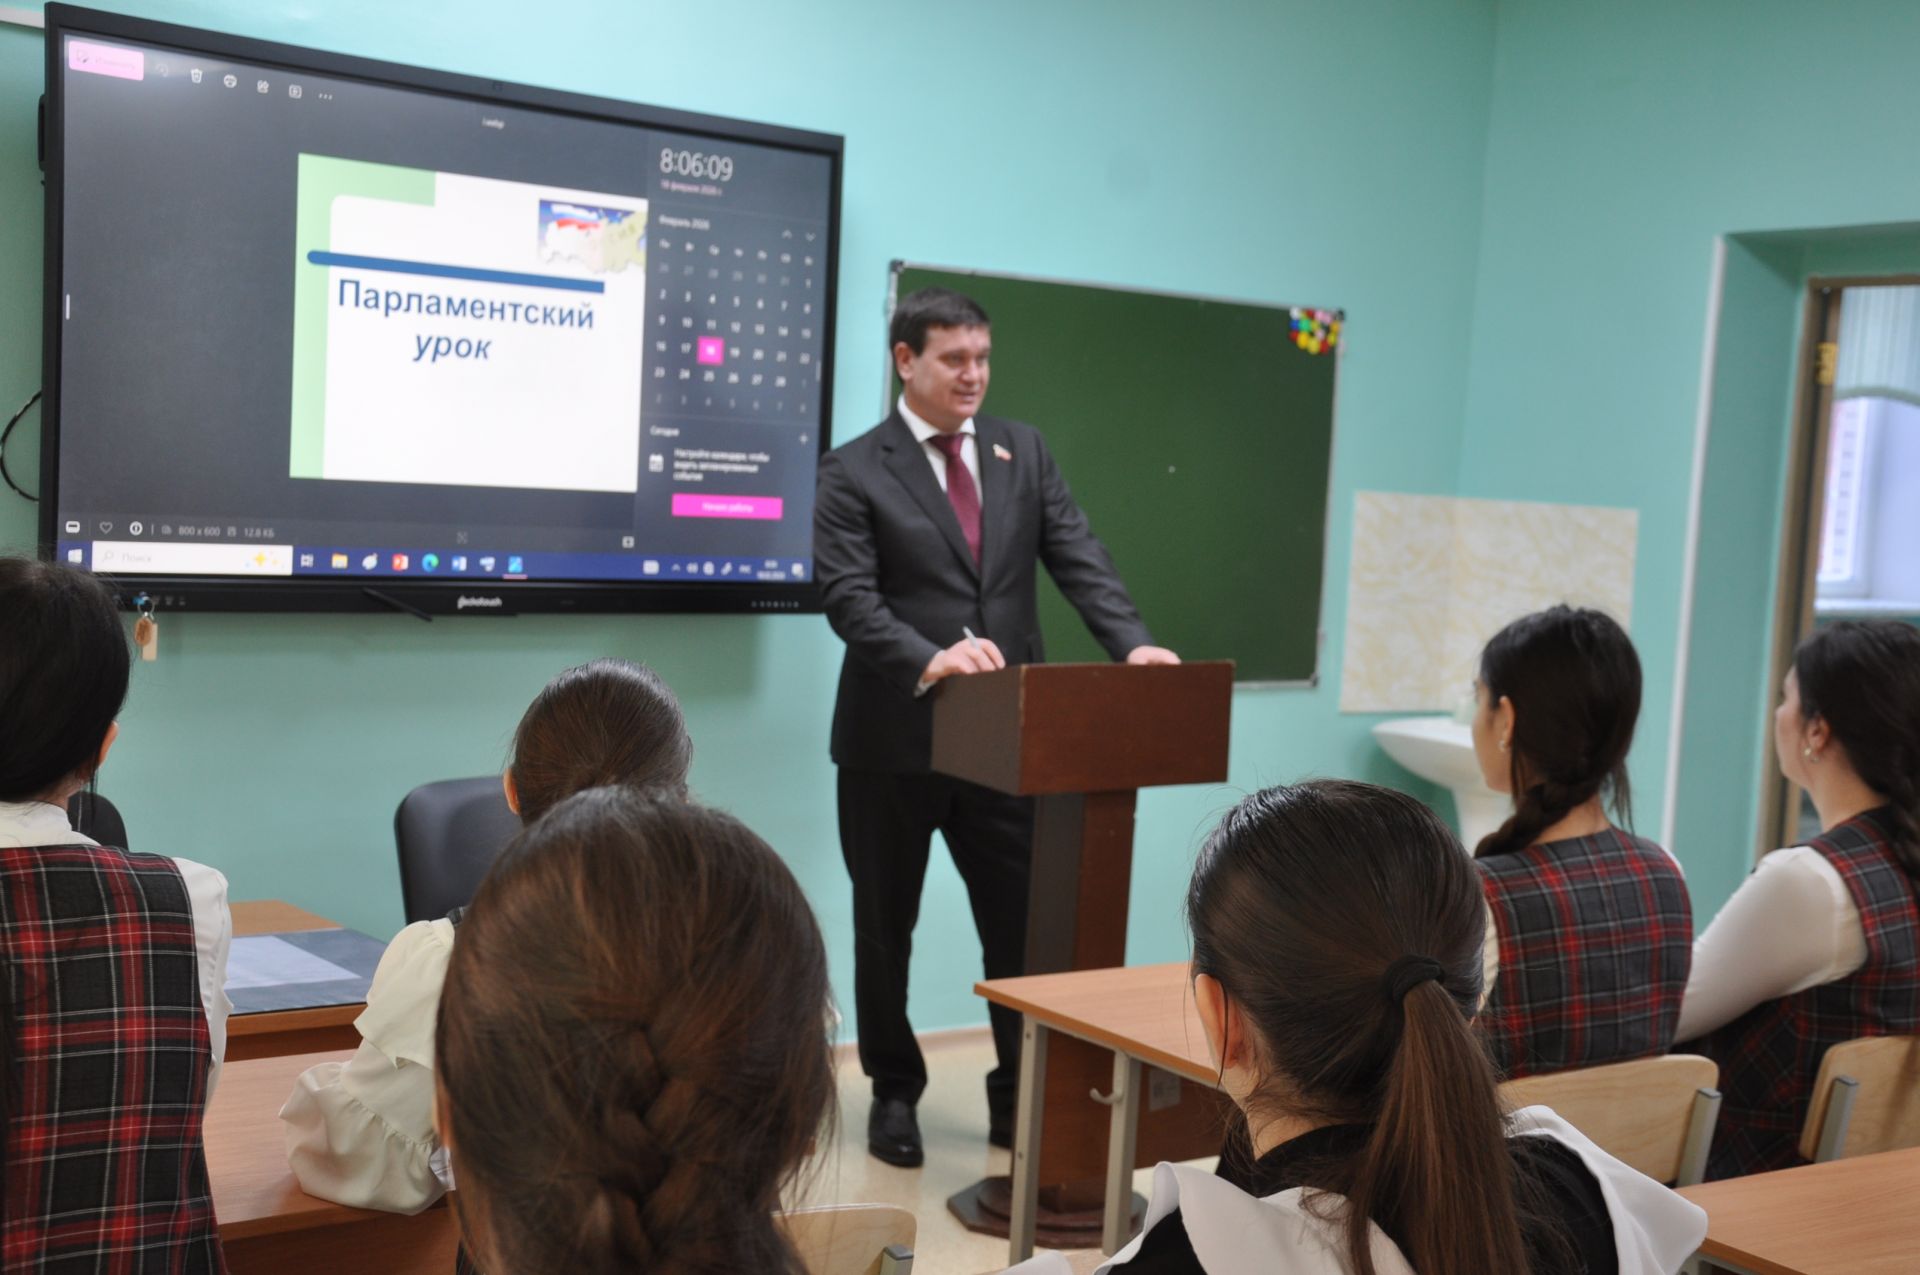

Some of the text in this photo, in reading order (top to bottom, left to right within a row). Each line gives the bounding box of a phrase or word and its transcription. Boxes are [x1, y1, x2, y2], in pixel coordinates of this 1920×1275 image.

[660, 148, 734, 181] 8:06:09
[338, 278, 595, 330] Парламентский
[413, 333, 493, 363] урок
[178, 526, 196, 536] 800
[203, 527, 221, 537] 600
